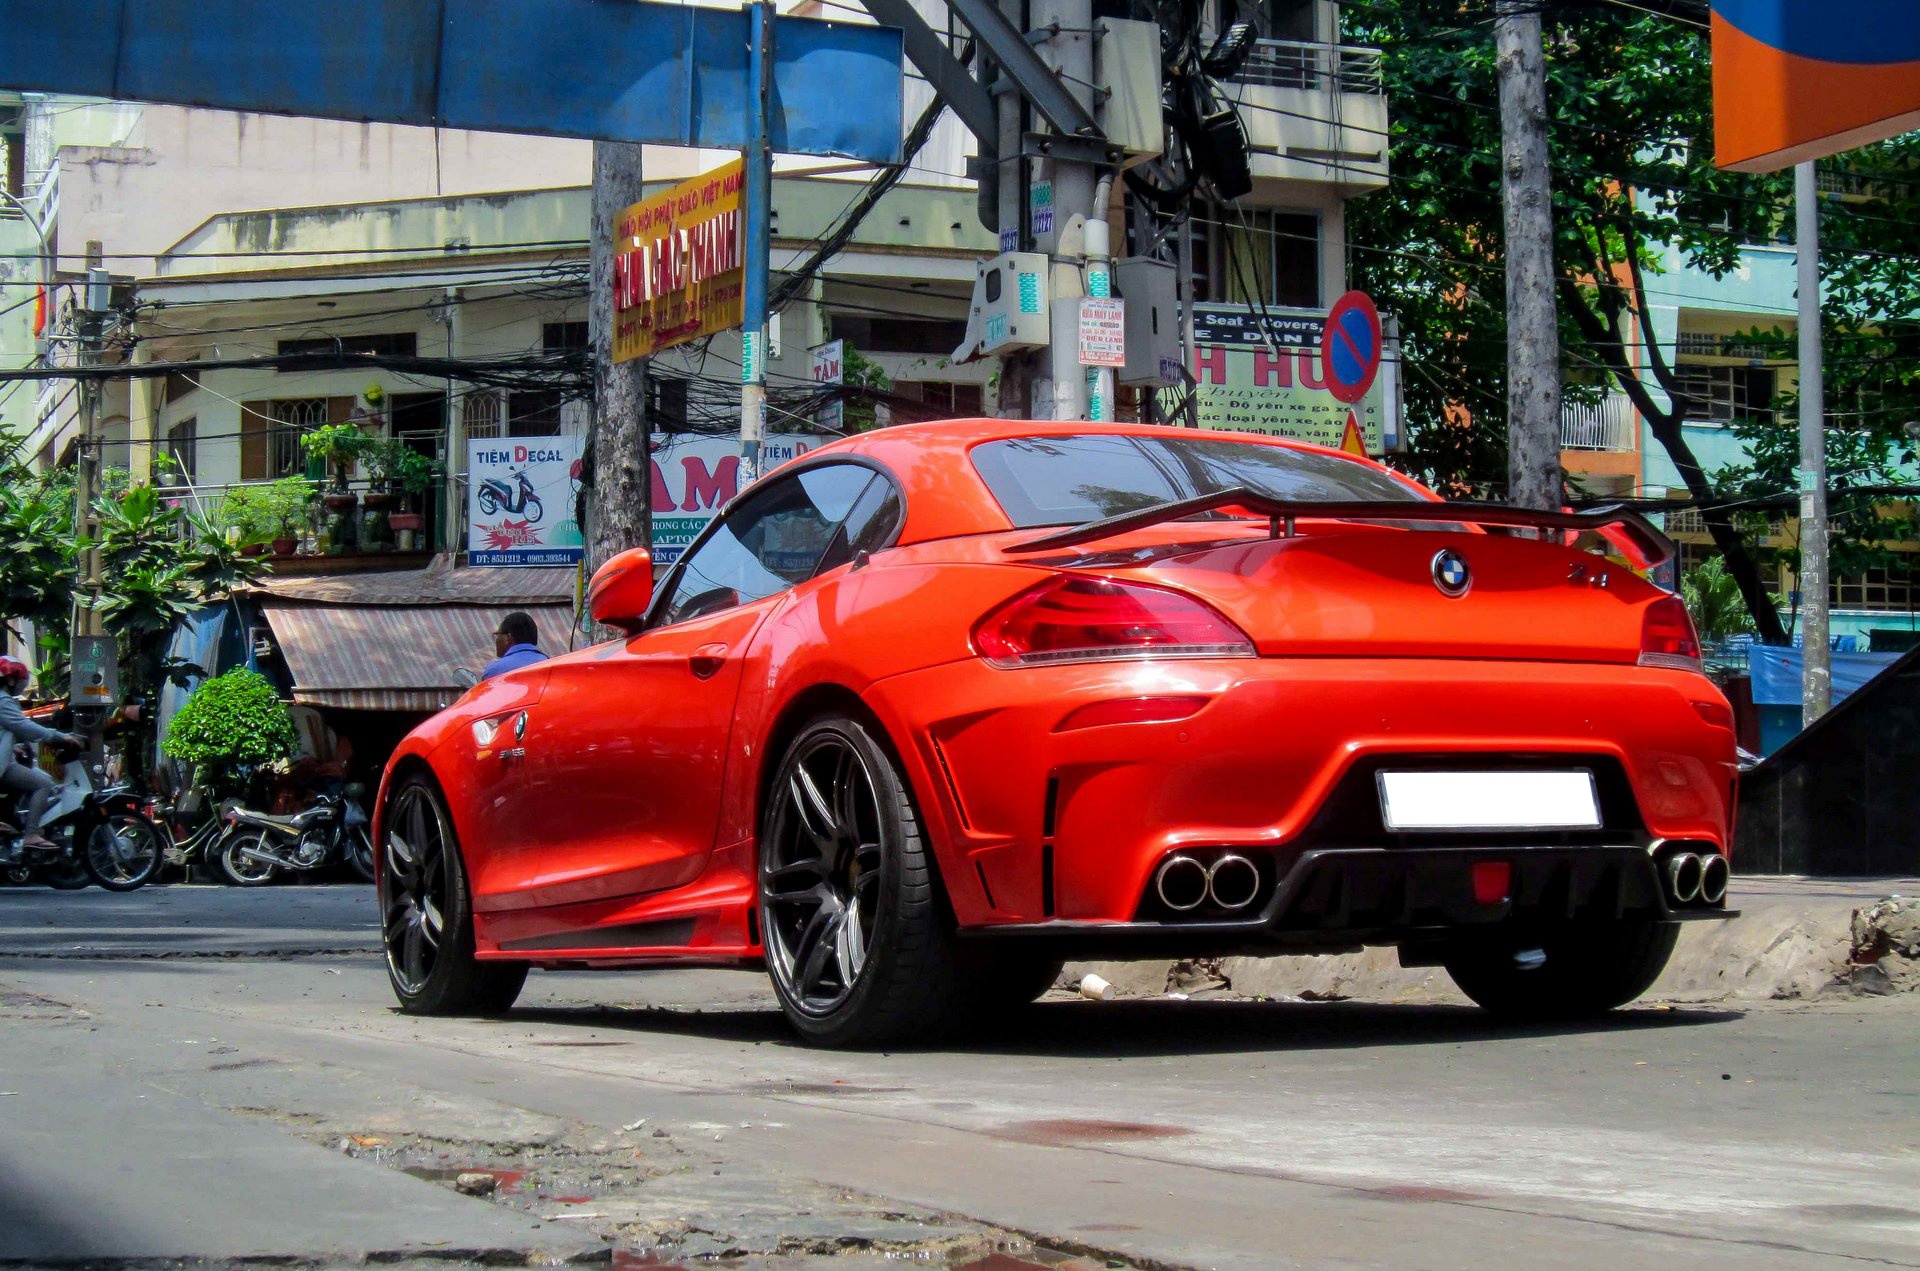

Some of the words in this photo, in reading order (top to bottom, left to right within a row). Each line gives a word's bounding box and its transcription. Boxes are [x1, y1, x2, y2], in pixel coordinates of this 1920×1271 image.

[1206, 314, 1244, 326] Seat
[1256, 401, 1284, 411] yên
[1312, 404, 1330, 413] ga
[1262, 415, 1290, 423] yên
[476, 449, 510, 467] TIỆM
[764, 443, 792, 461] TIỆM
[653, 521, 679, 530] RONG
